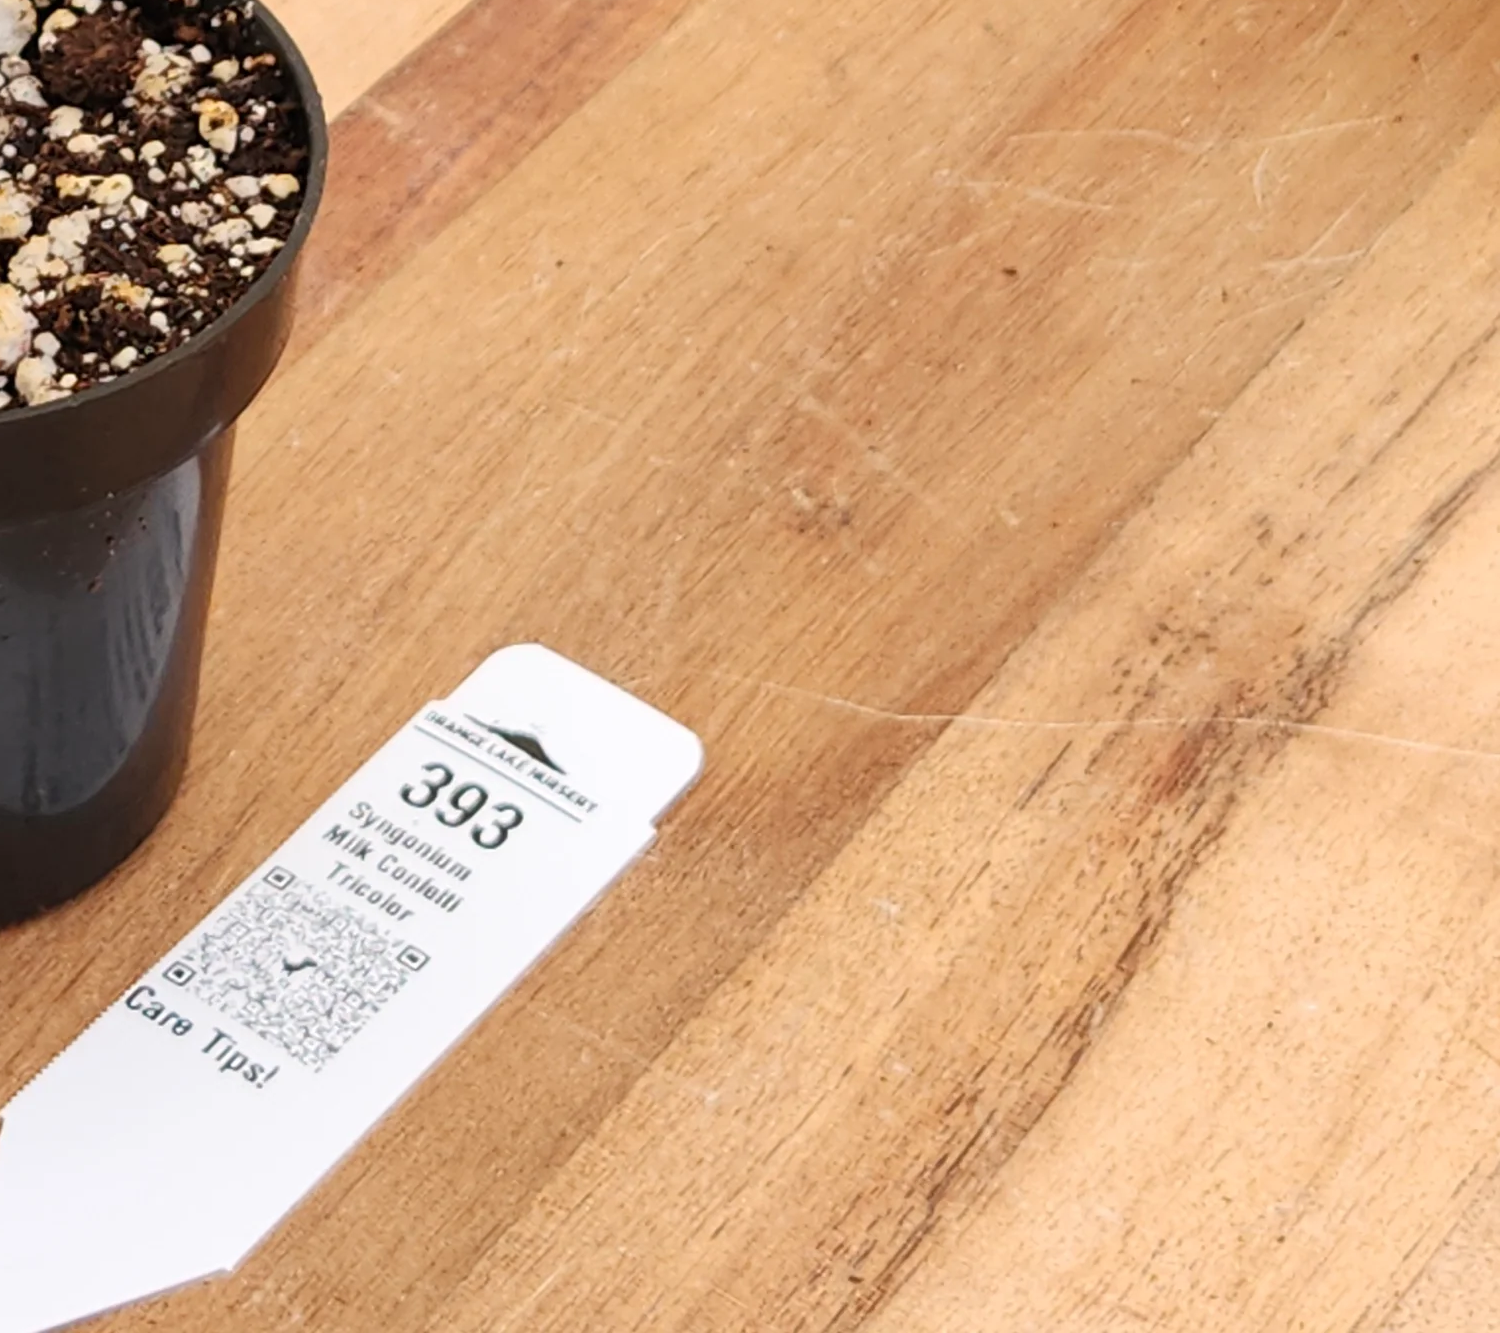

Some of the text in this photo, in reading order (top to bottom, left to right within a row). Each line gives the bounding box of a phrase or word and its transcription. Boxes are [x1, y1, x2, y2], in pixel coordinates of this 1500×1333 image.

[322, 823, 375, 861] Milk
[349, 800, 472, 882] Syngonium
[400, 761, 524, 849] 393
[326, 860, 415, 921] Tricolor
[125, 985, 280, 1089] Care Tips!
